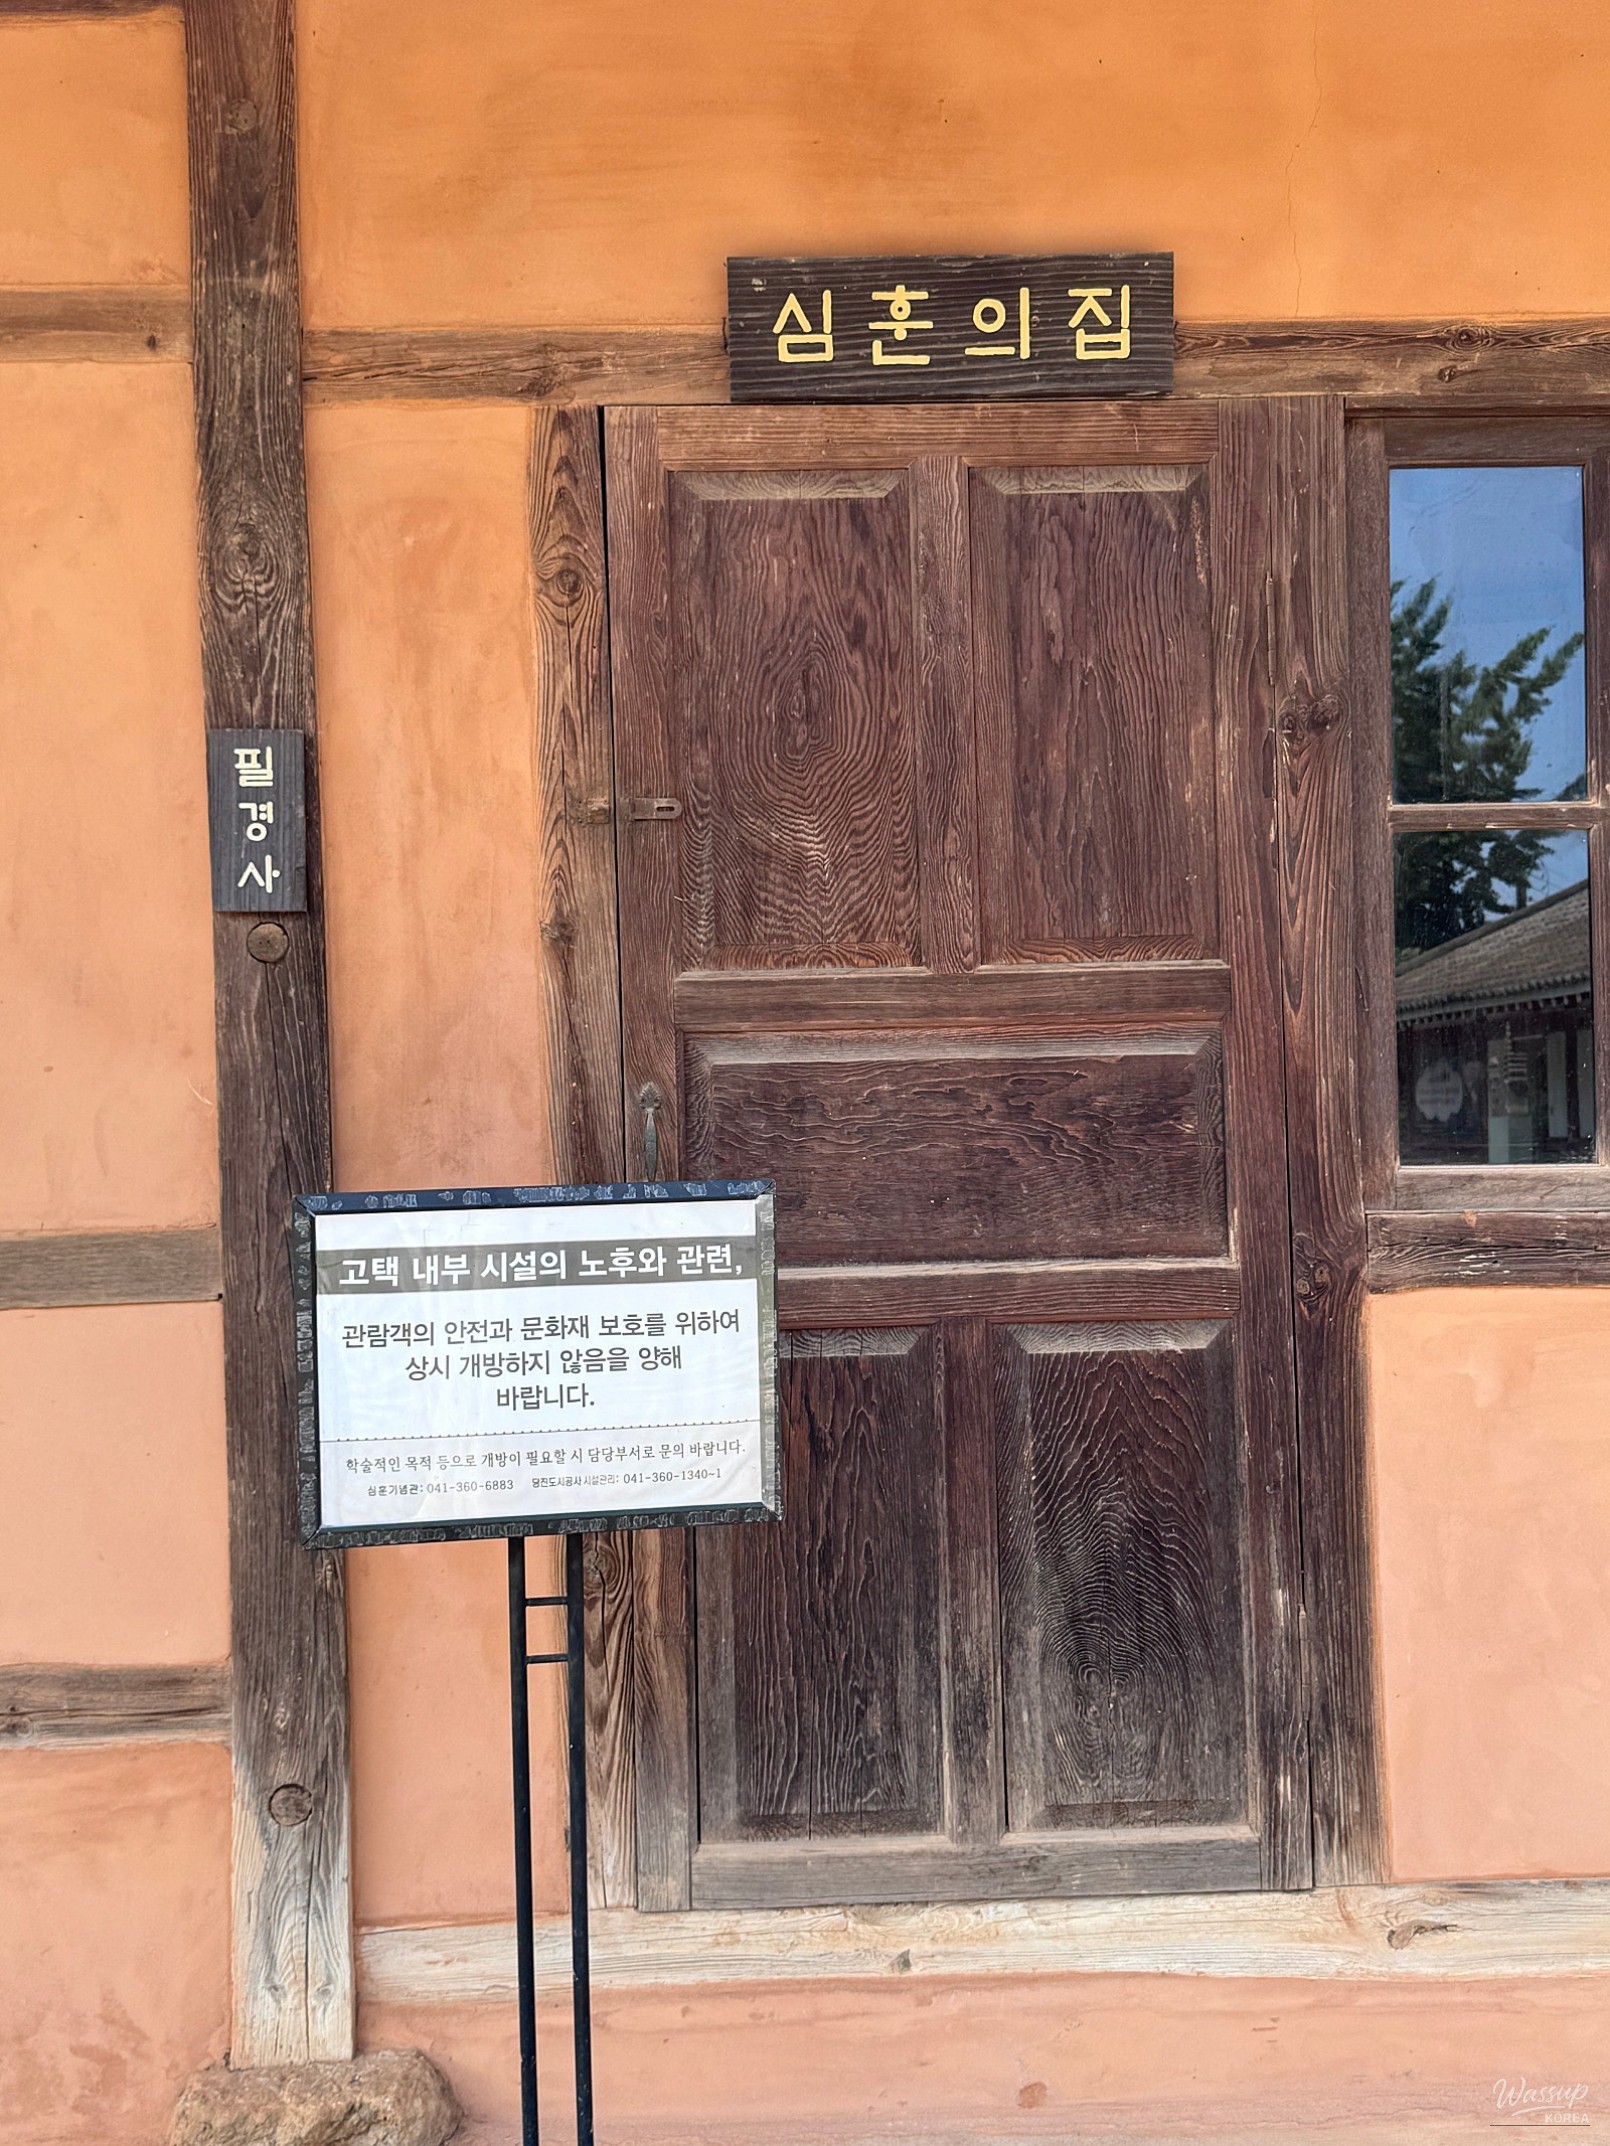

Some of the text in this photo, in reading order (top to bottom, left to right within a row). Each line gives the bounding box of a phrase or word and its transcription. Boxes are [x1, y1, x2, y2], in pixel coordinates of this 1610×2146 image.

[232, 745, 281, 894] 필경사
[338, 1243, 743, 1287] 고택 내부 시설의 노후와 관련,
[341, 1308, 741, 1349] 관람객의 안전과 문화재 보호를 위하여
[405, 1344, 682, 1381] 상시 개방하지 않음을 양해
[497, 1383, 595, 1412] 바랍니다.
[346, 1439, 746, 1474] 학술적인 목적 등으로 개방이 필요할 시 담당부서로 문의 바랍니다.
[426, 1480, 515, 1494] 041-360-6883
[623, 1468, 722, 1484] 041-360-1340~1
